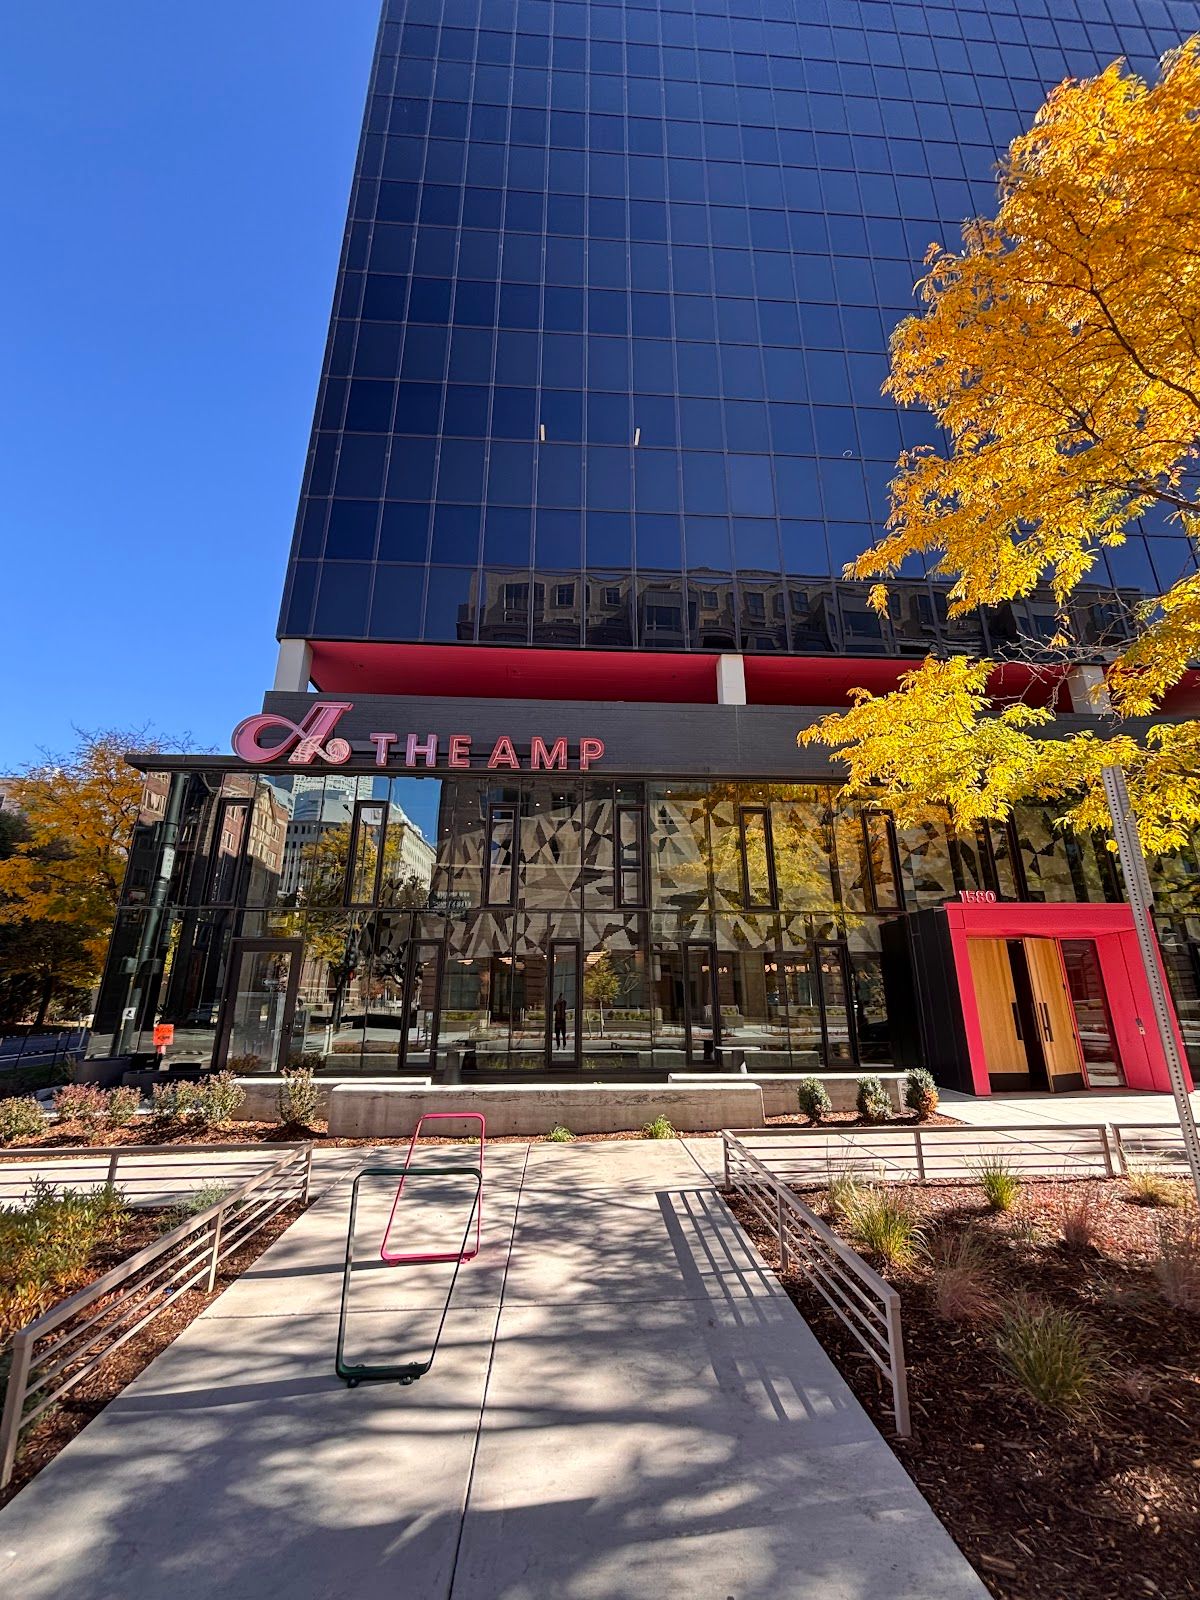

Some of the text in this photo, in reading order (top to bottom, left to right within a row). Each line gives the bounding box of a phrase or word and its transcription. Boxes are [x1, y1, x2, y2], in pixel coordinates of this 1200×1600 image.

[370, 732, 605, 770] THE AMP
[958, 890, 997, 904] 1580
